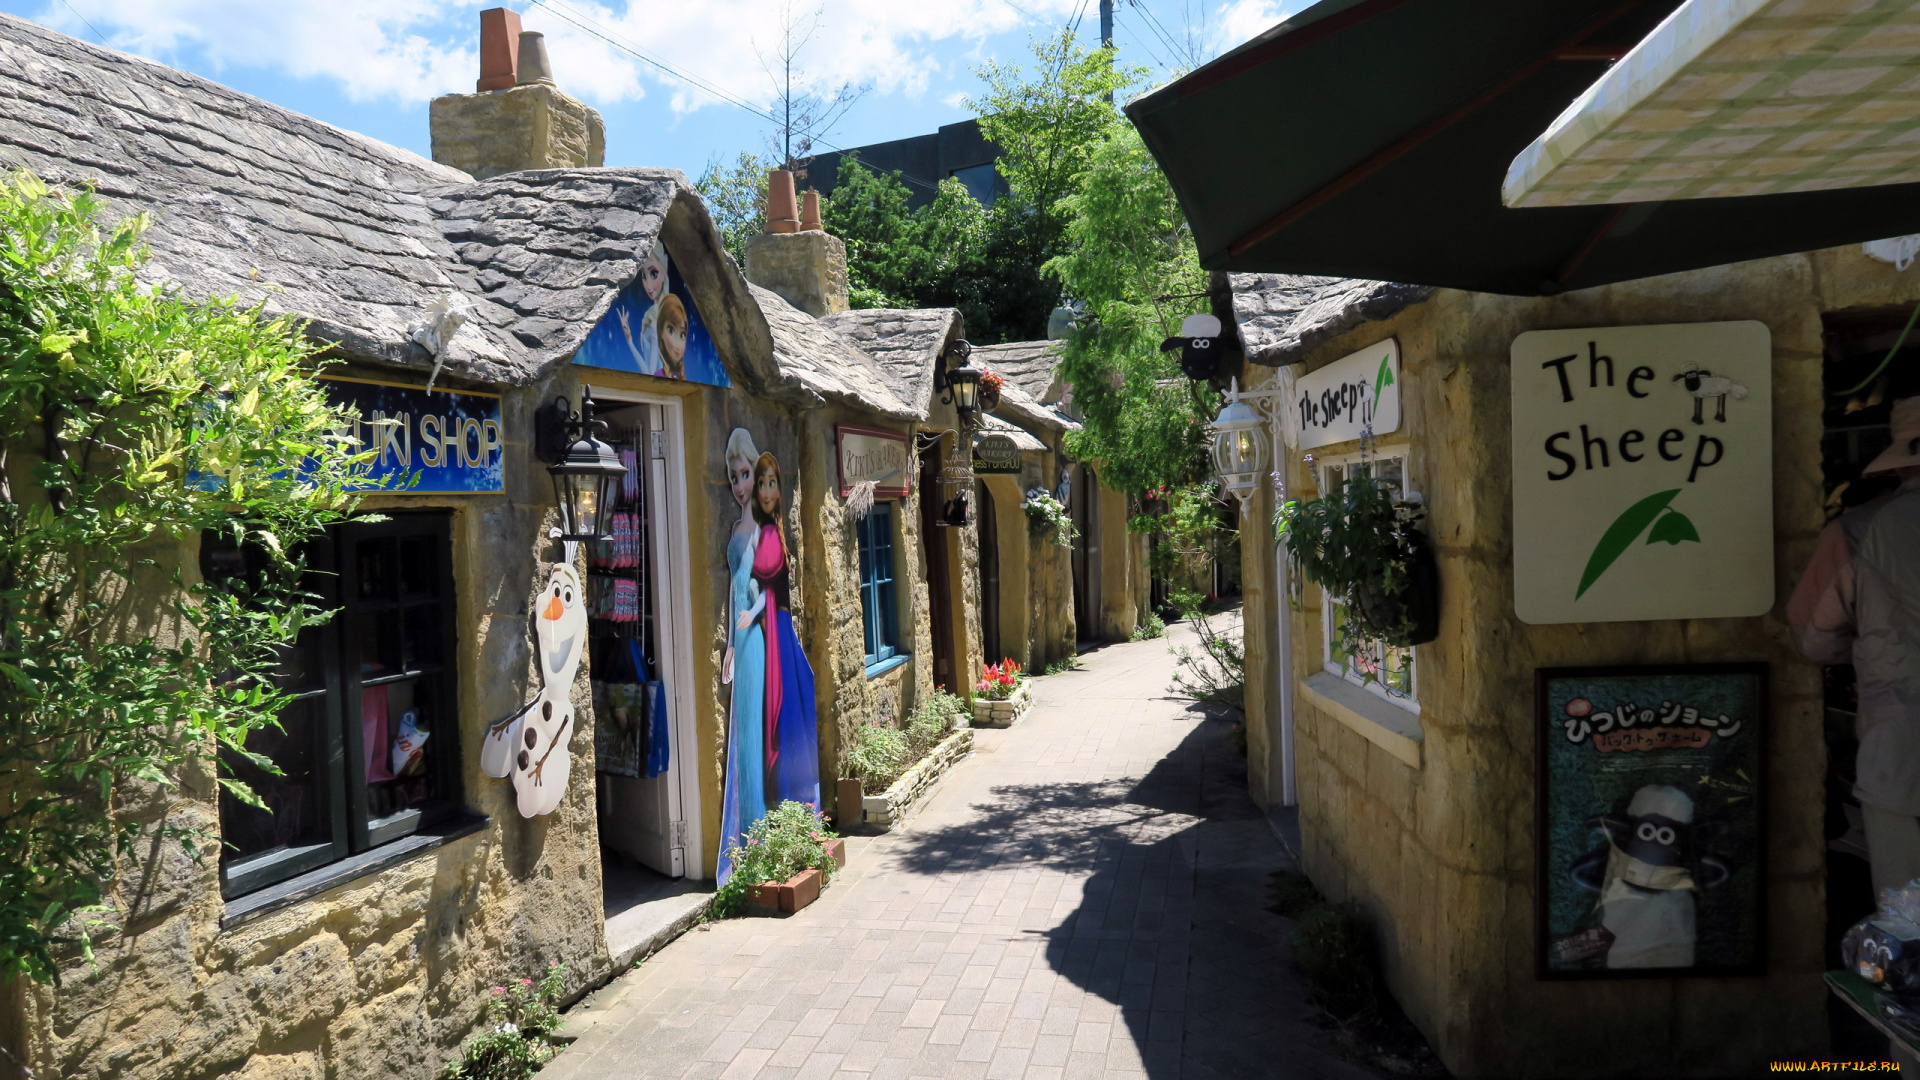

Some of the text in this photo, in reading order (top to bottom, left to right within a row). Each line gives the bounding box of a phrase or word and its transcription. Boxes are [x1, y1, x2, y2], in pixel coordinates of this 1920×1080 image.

[1541, 341, 1656, 403] The
[1299, 382, 1357, 431] The Sheep
[420, 413, 502, 469] SHOP
[846, 448, 875, 480] KIKI'S
[1544, 424, 1725, 483] Sheep
[1563, 700, 1742, 744] ひつじのショーン
